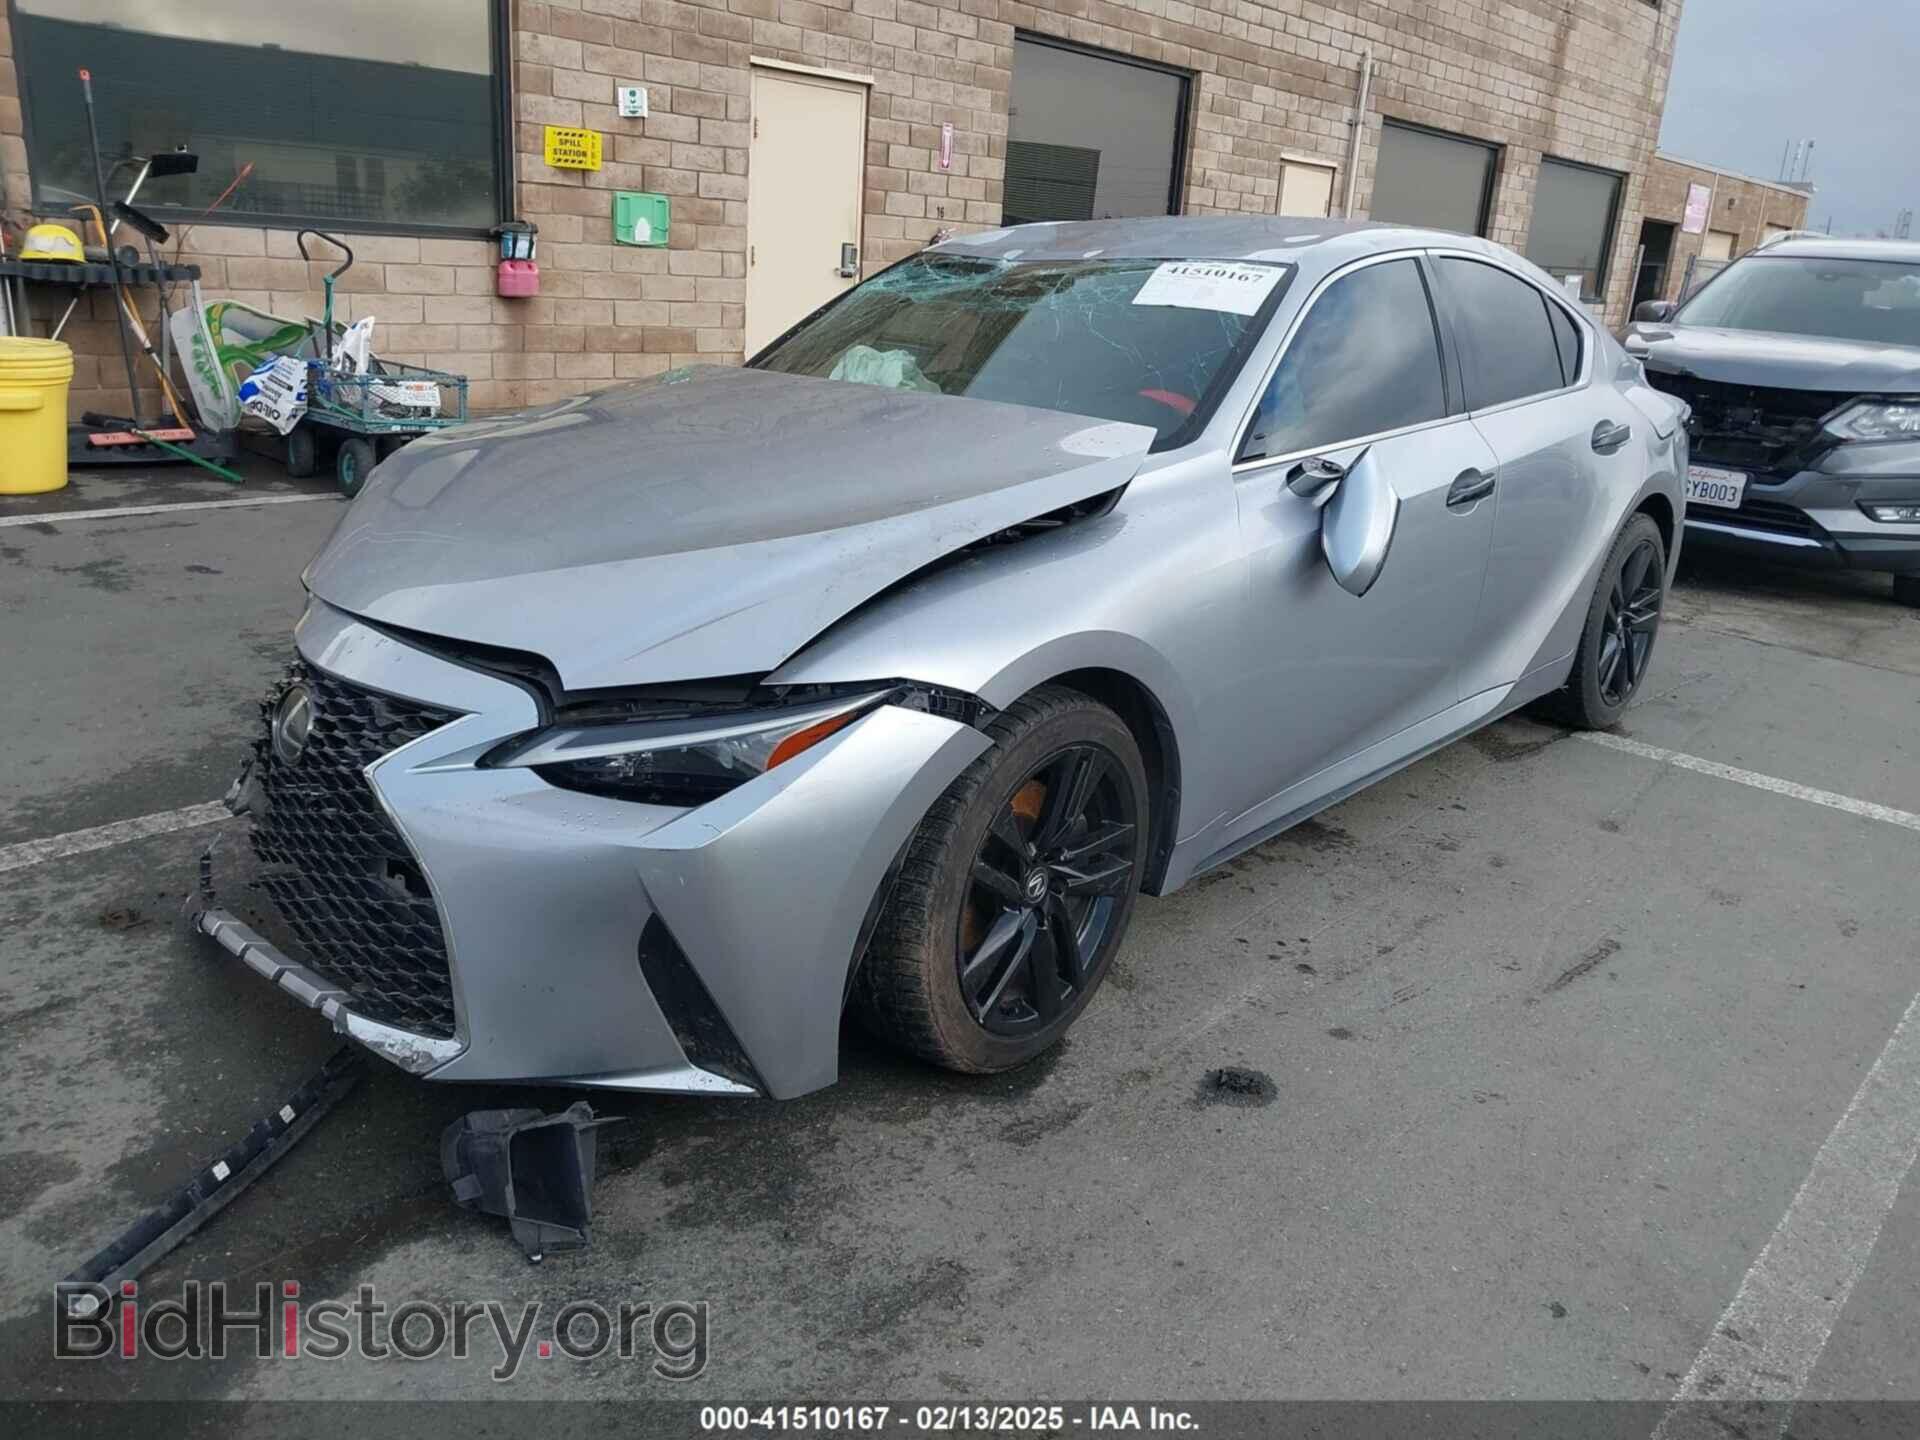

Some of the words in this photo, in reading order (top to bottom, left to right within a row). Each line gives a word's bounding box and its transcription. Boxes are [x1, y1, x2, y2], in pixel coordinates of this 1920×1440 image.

[559, 138, 582, 147] SPILL
[553, 148, 587, 158] STATION
[1167, 266, 1264, 282] 41510167
